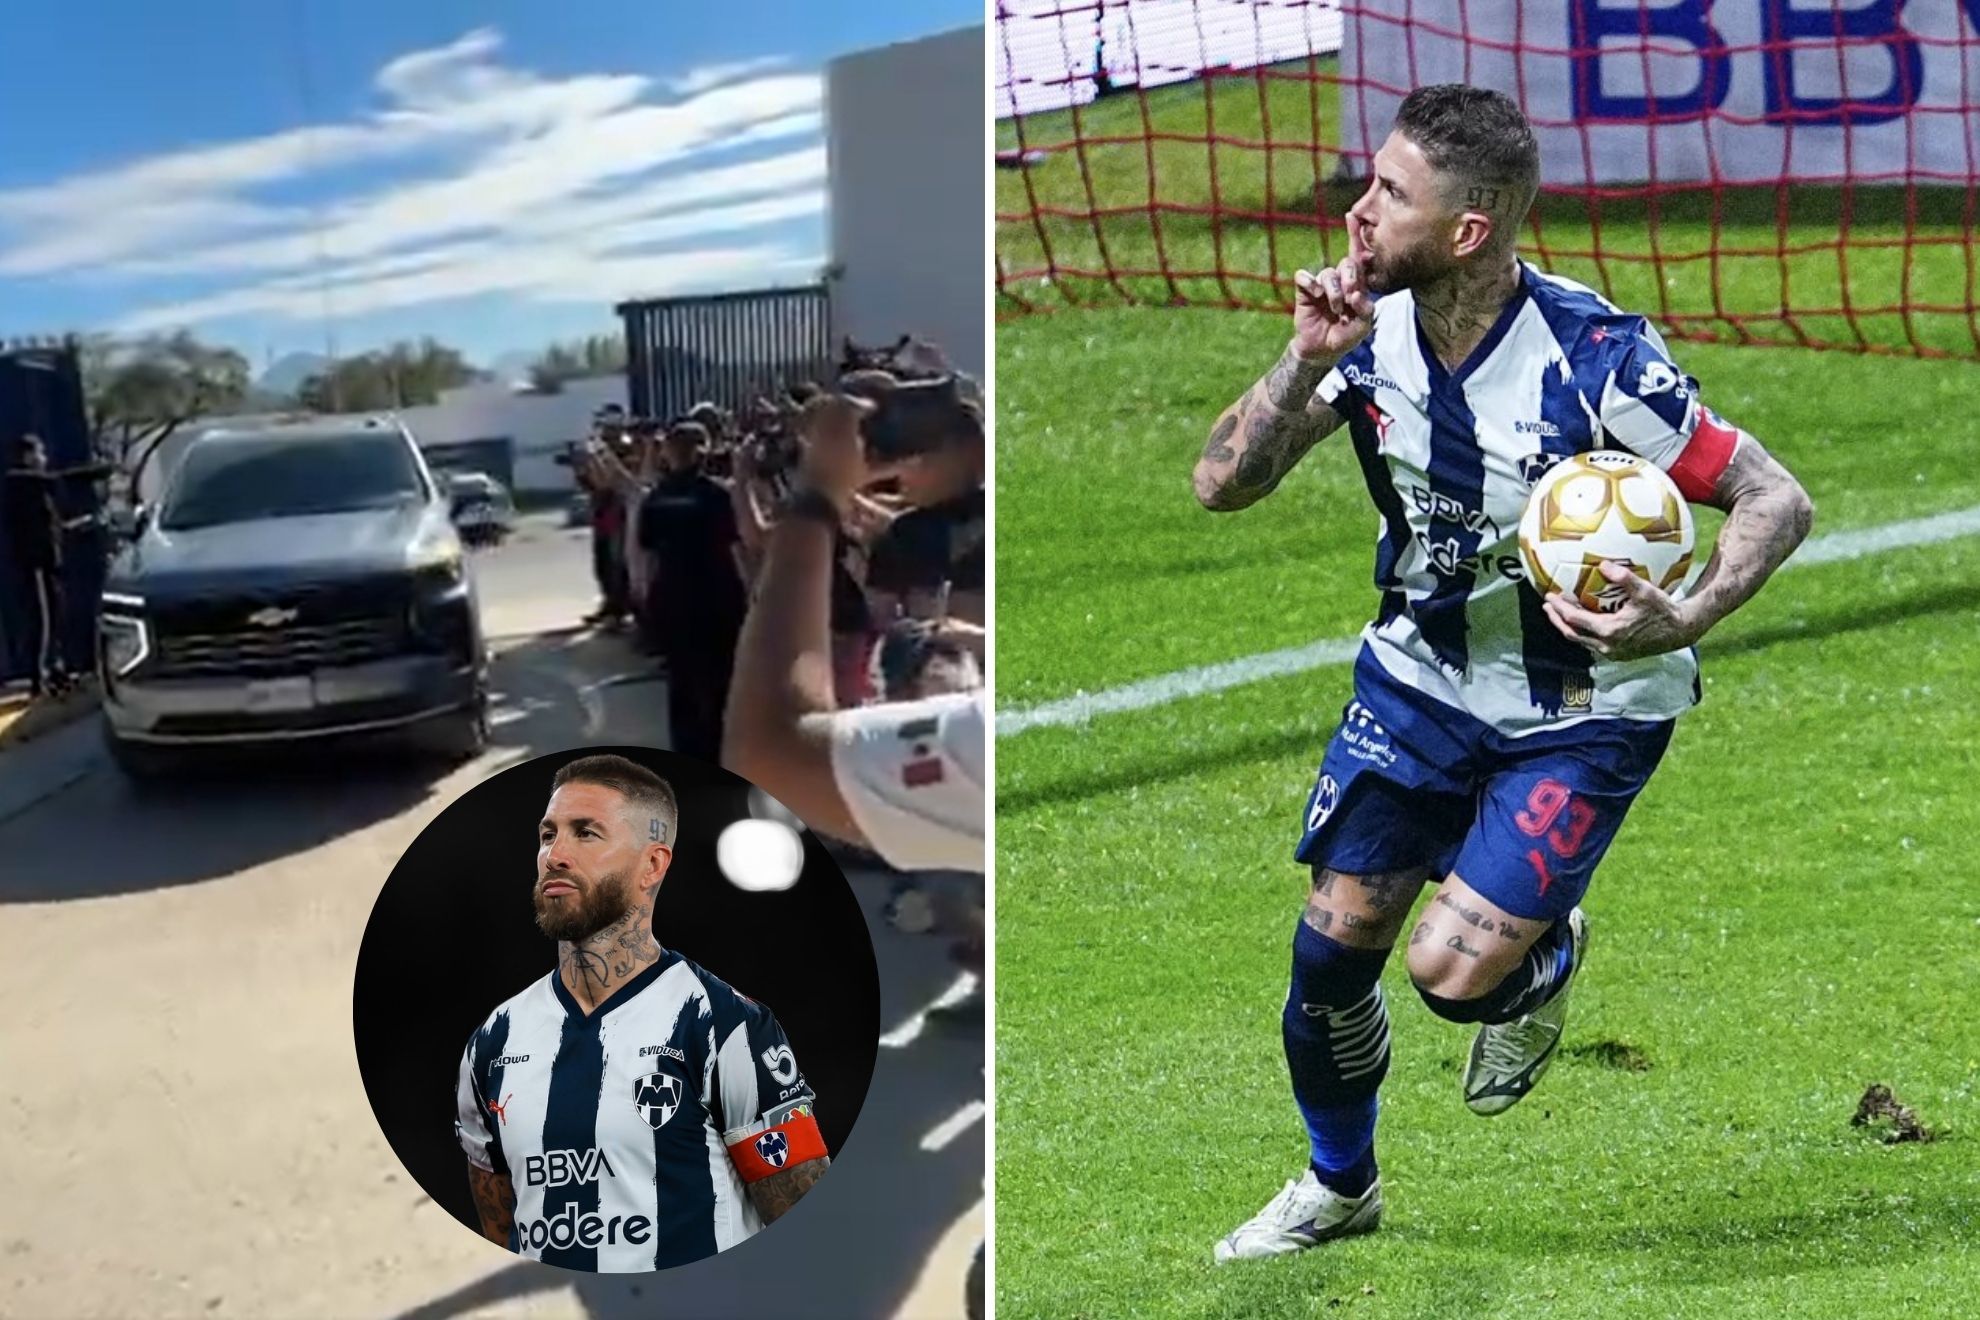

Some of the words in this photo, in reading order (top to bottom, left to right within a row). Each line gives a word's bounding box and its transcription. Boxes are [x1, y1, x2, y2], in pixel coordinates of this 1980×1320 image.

[1568, 0, 1980, 127] BB
[648, 818, 668, 843] 93
[1514, 778, 1597, 858] 93
[525, 1148, 616, 1188] BBVA
[518, 1203, 652, 1251] codere
